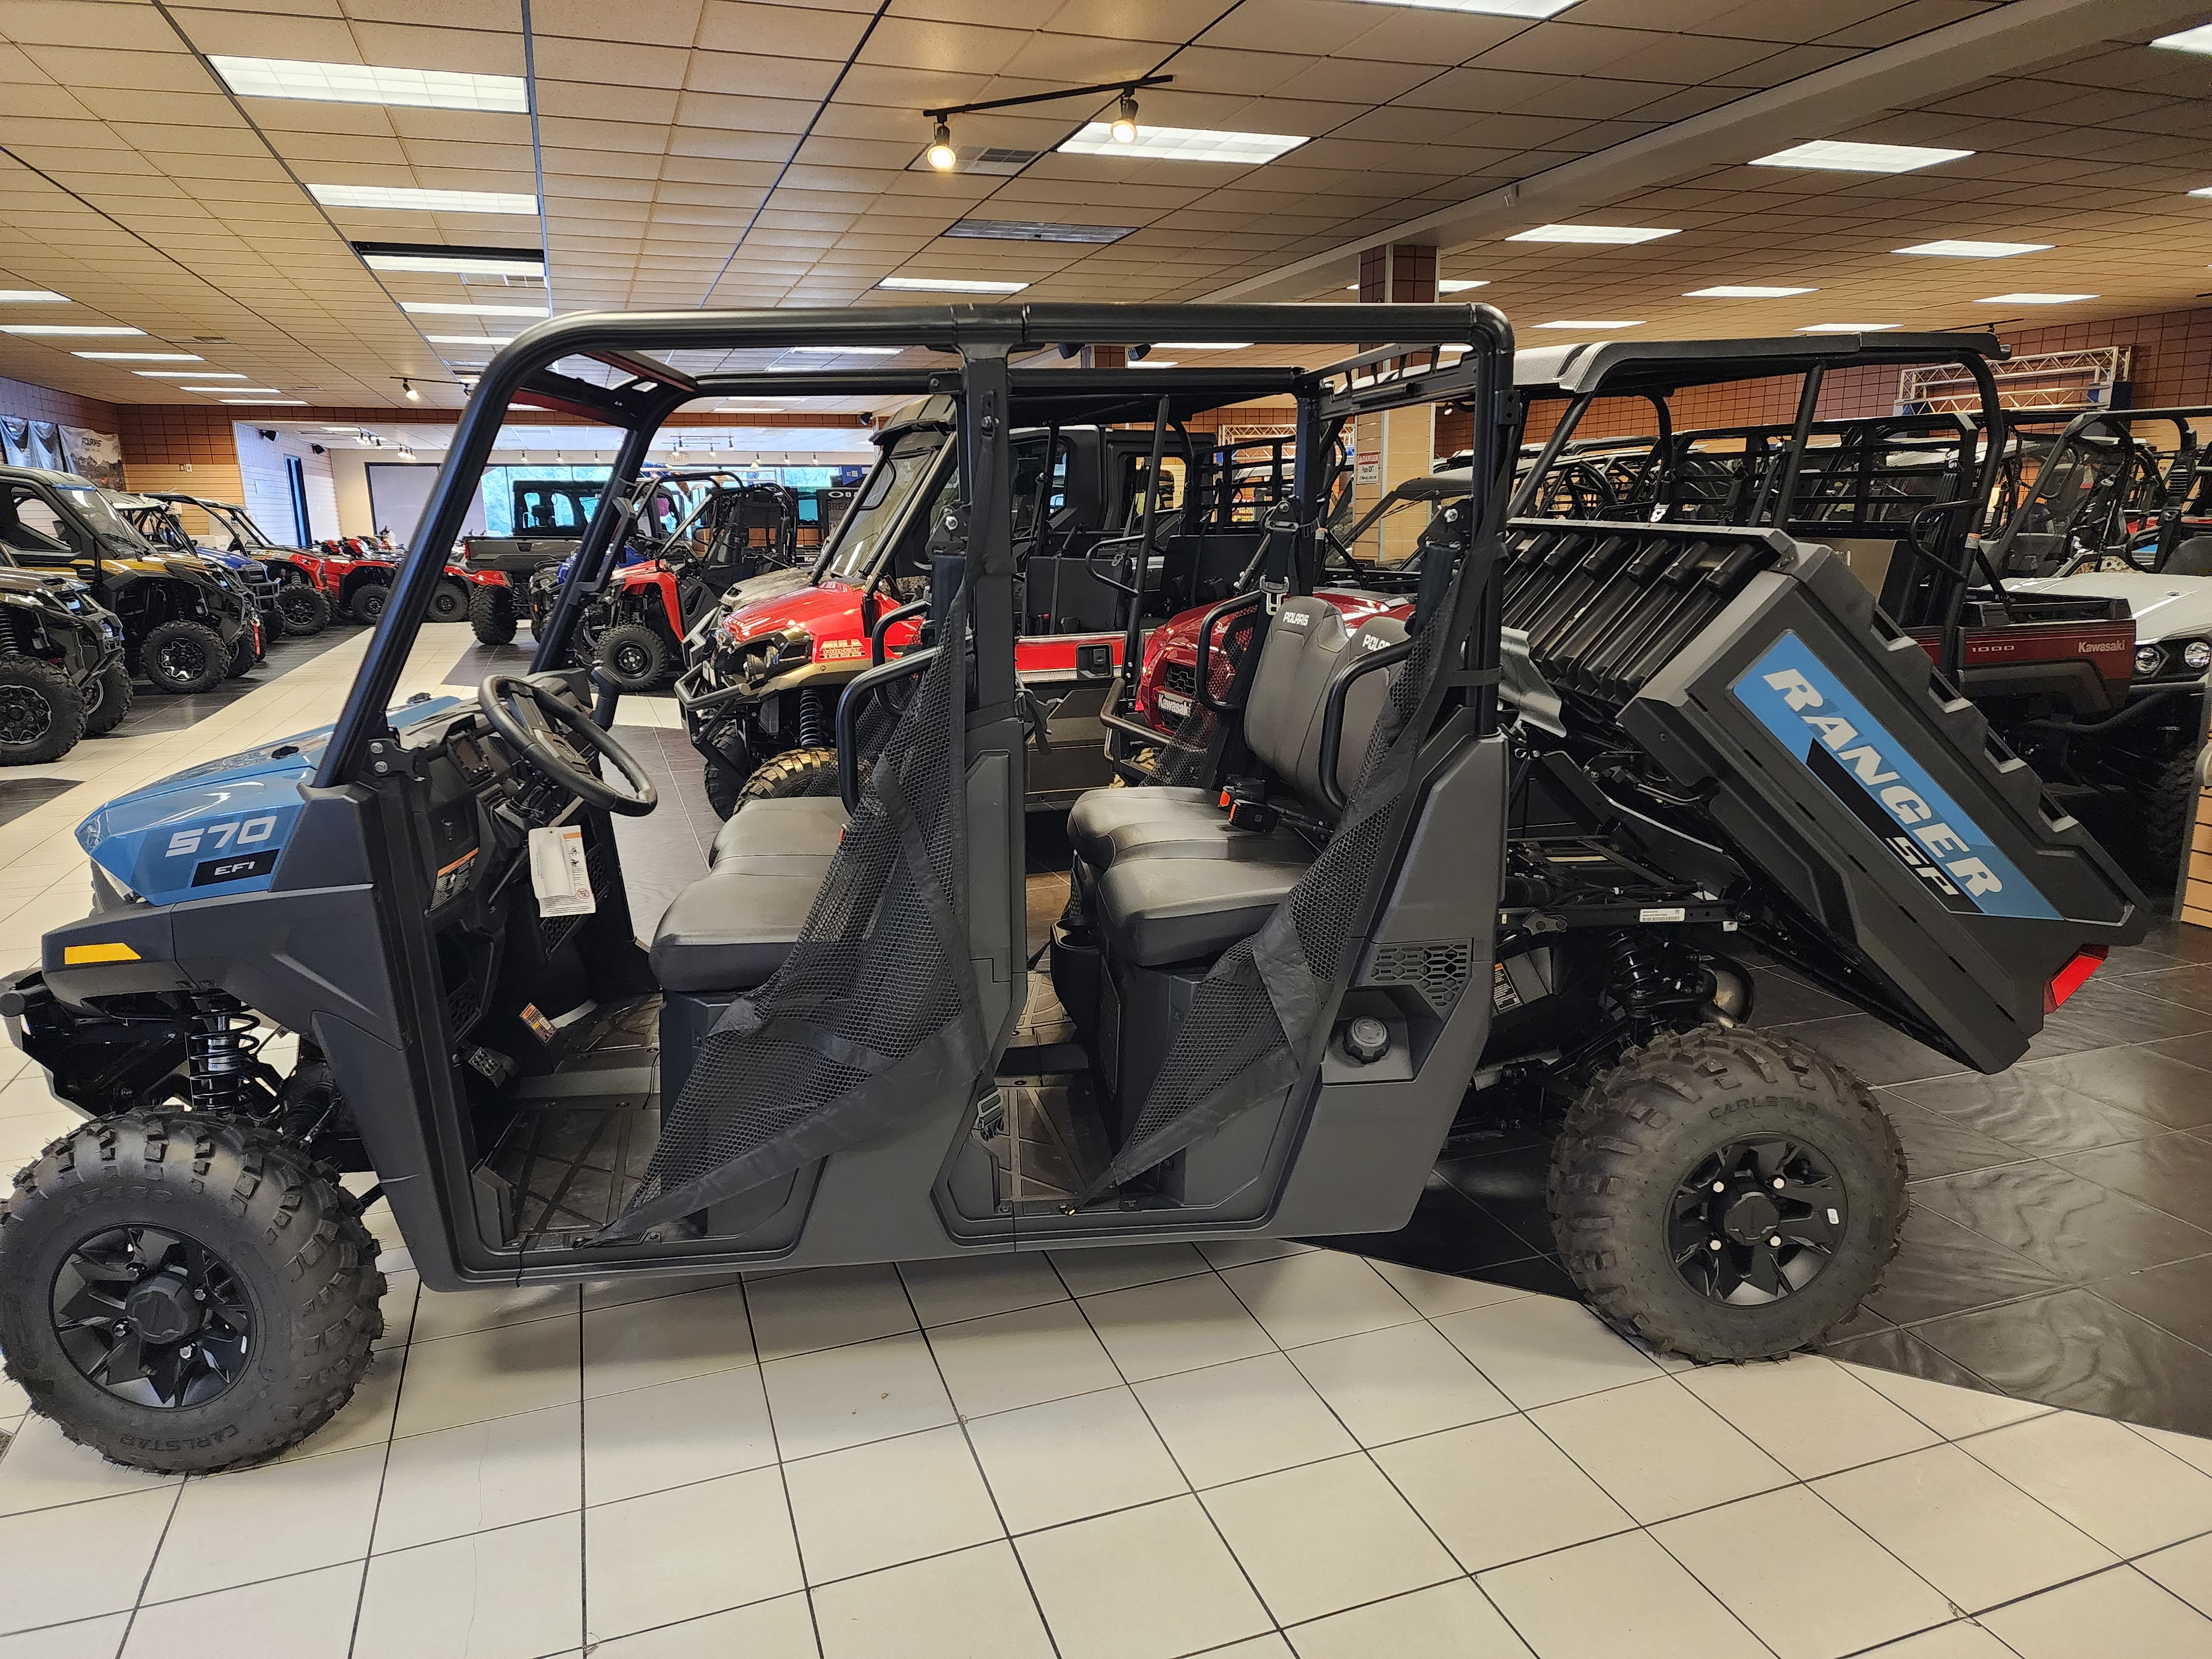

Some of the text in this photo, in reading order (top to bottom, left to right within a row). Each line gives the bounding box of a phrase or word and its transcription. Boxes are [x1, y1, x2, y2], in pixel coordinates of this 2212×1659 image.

[827, 502, 850, 510] BREA
[1282, 612, 1310, 626] POLARIS
[820, 639, 864, 651] MULE
[2078, 639, 2125, 653] Kawasaki
[1158, 693, 1192, 717] Kawasaki
[1762, 668, 2002, 898] RANGER
[165, 815, 277, 857] 570
[214, 861, 255, 875] EFI
[1885, 837, 1959, 895] SP
[1709, 1095, 1818, 1120] CARLSTAR
[119, 1423, 238, 1452] CARLSTAR
